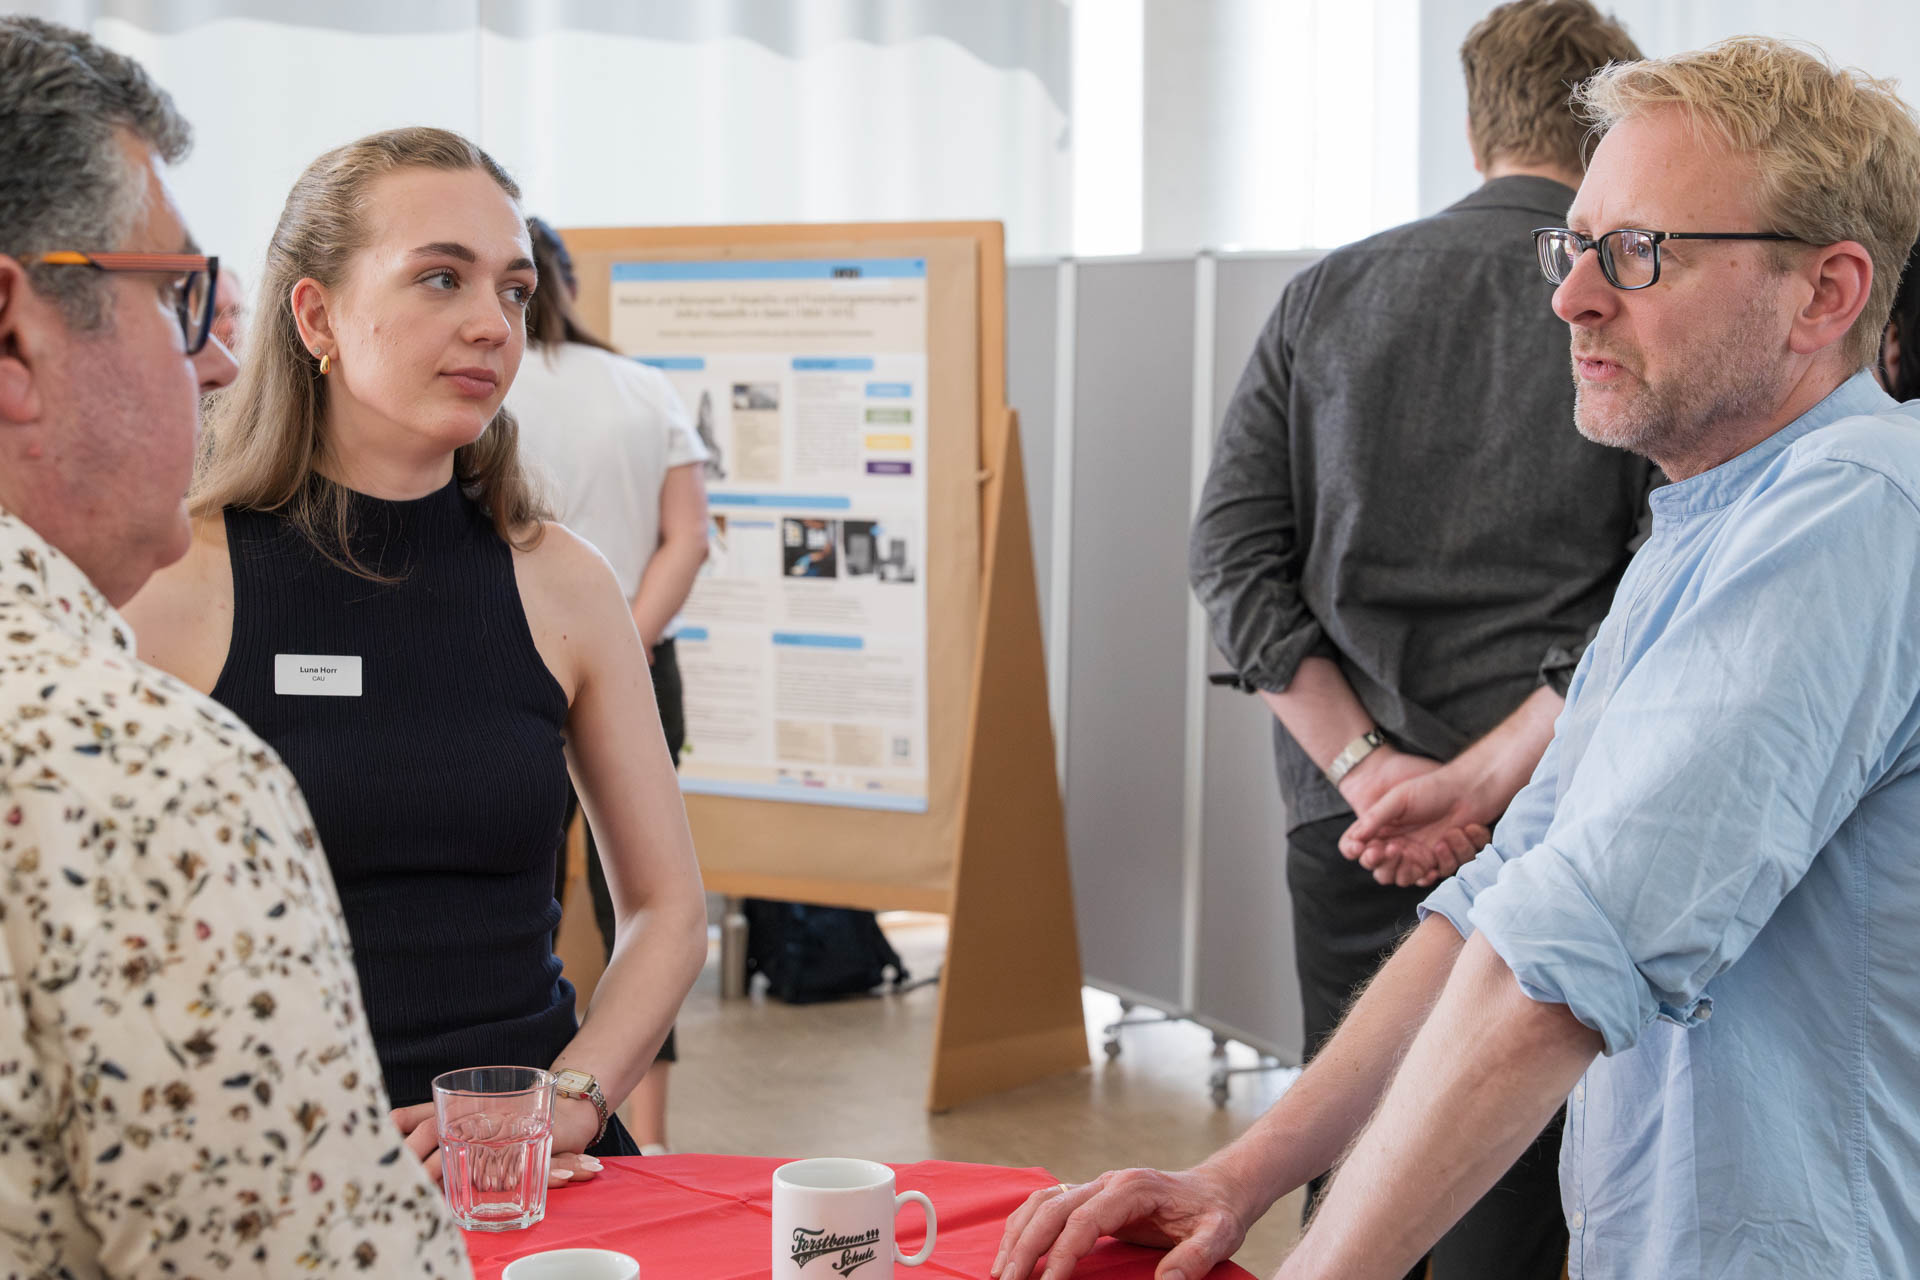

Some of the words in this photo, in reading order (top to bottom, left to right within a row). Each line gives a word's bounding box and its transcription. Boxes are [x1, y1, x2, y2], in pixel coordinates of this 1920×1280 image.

[299, 666, 319, 674] Luna
[320, 666, 338, 674] Horr
[791, 1227, 865, 1253] Forstbaum
[831, 1247, 874, 1271] Schule
